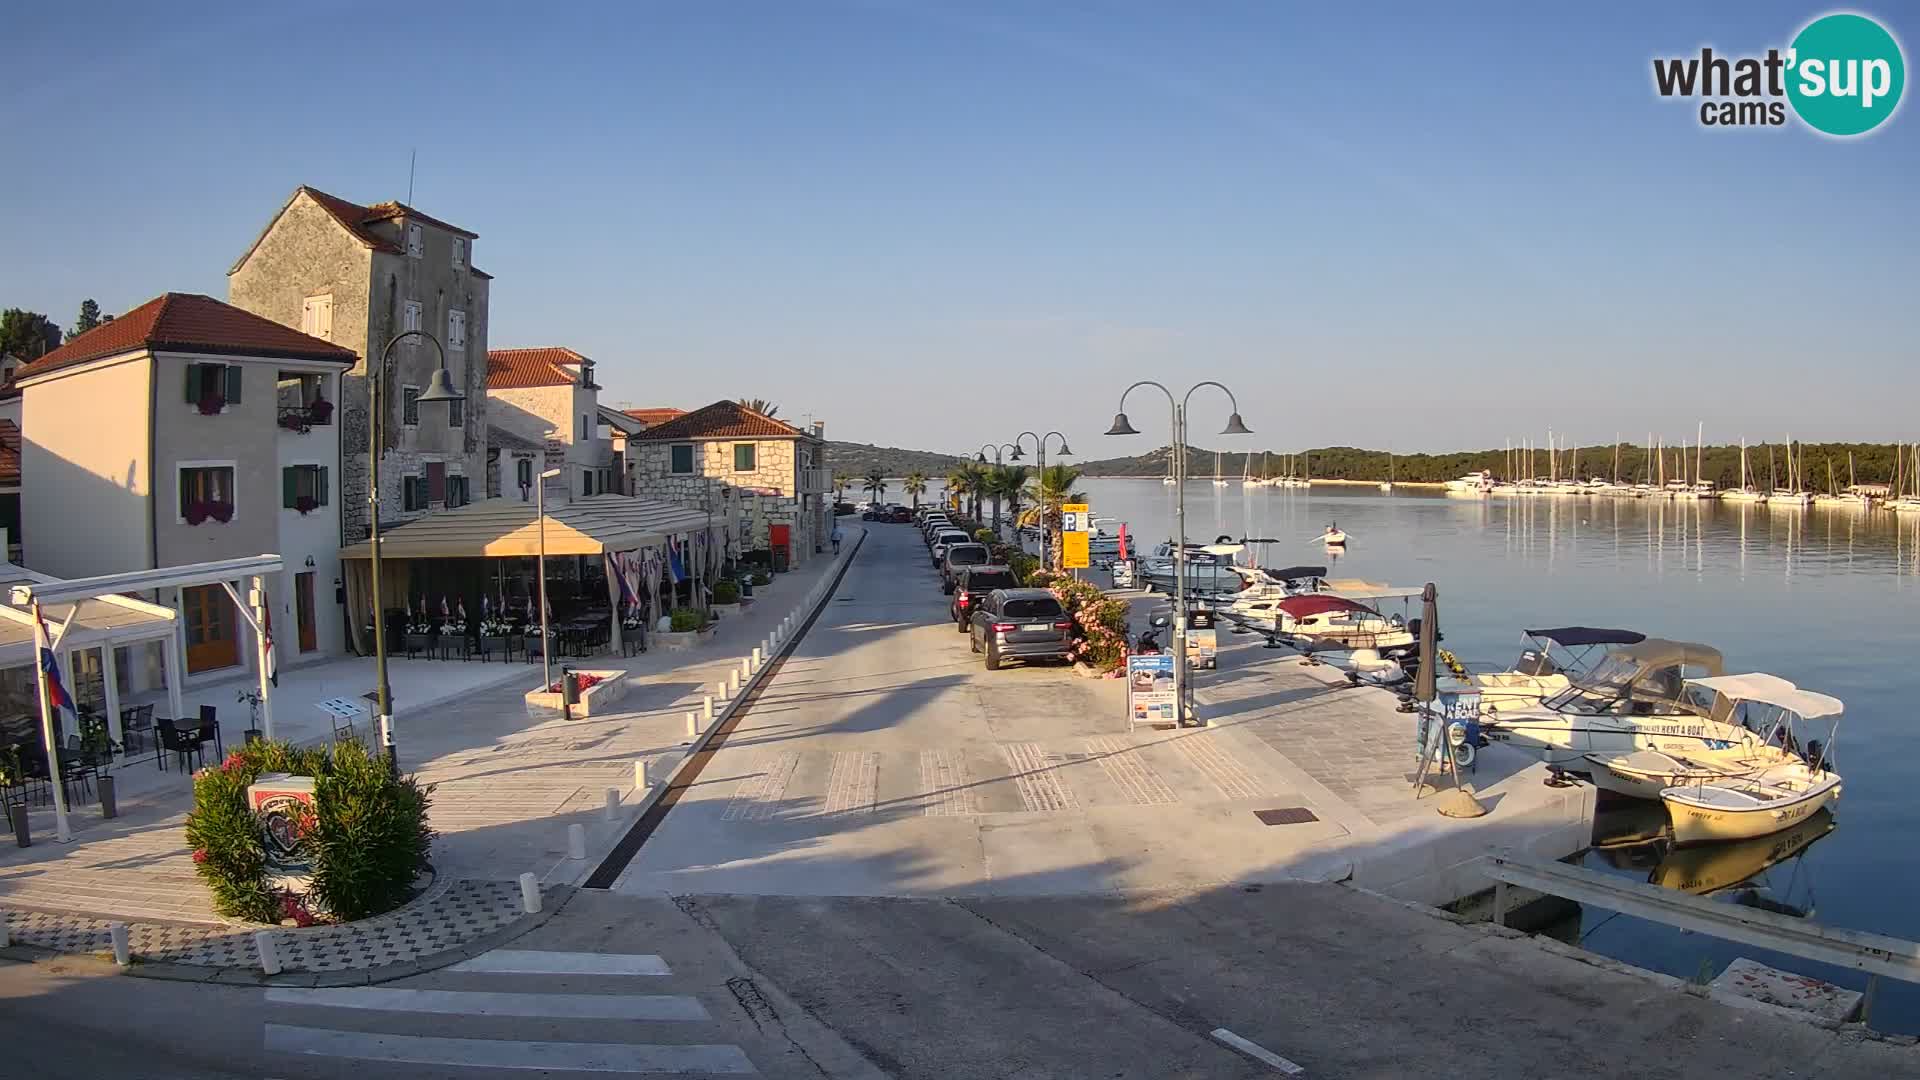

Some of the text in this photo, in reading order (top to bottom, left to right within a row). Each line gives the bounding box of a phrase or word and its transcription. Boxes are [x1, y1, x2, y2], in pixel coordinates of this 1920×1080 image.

[1065, 514, 1076, 530] P
[1662, 725, 1680, 734] RENT
[1687, 726, 1704, 736] BOAT
